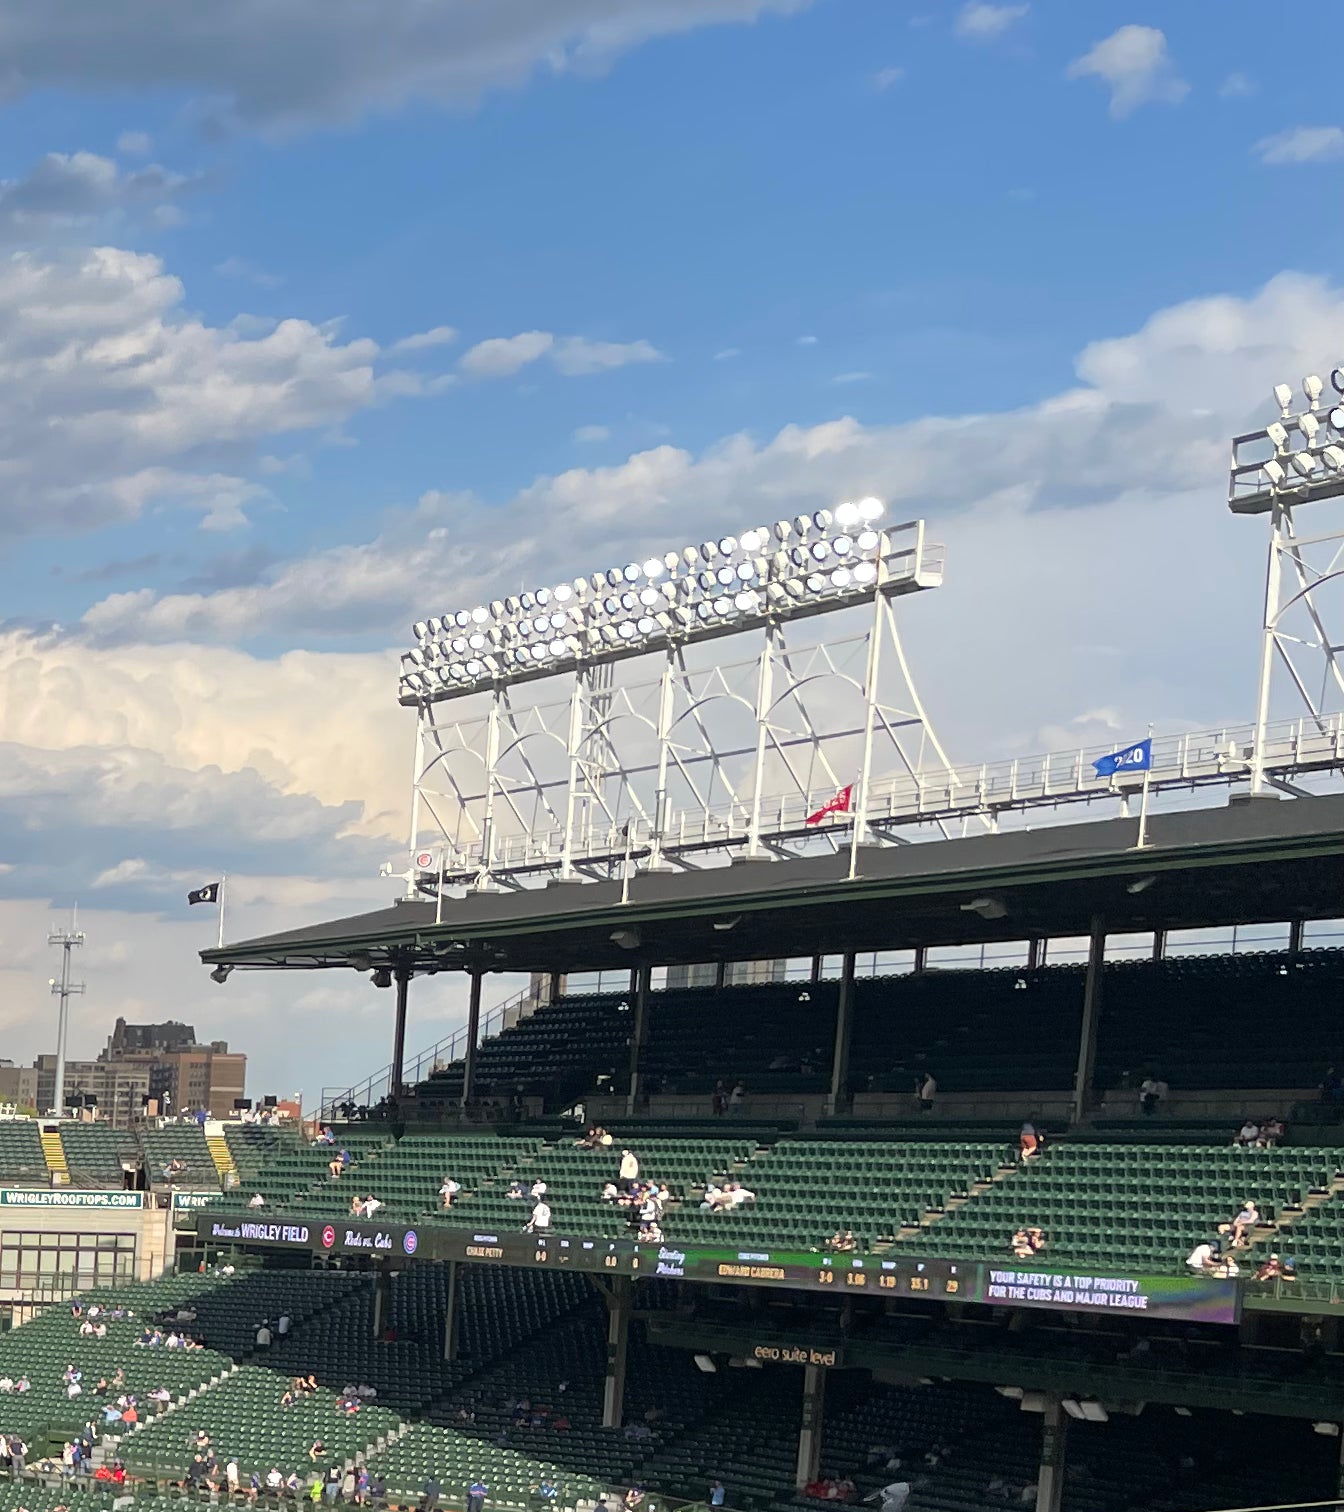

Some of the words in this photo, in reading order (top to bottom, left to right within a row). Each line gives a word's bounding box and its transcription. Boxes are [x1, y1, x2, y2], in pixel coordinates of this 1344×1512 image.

[6, 1192, 137, 1206] WRIGLEYROOFTOPS.COM
[241, 1223, 281, 1241] WRIGLEY
[282, 1226, 309, 1243] FIELD
[989, 1270, 1015, 1284] YOUR
[1017, 1271, 1051, 1286] SAFETY
[1053, 1274, 1063, 1287] IS
[1063, 1274, 1072, 1287] A
[1073, 1275, 1092, 1289] TOP
[1093, 1277, 1139, 1293] PRIORITY
[988, 1284, 1006, 1298] FOR
[1008, 1286, 1025, 1299] THE
[1026, 1287, 1052, 1301] CUBS
[1053, 1289, 1074, 1303] AND
[1074, 1290, 1108, 1305] MAJOR
[1109, 1293, 1148, 1309] LEAGUE
[754, 1346, 780, 1360] eero
[782, 1346, 808, 1362] suite
[809, 1348, 836, 1366] level
